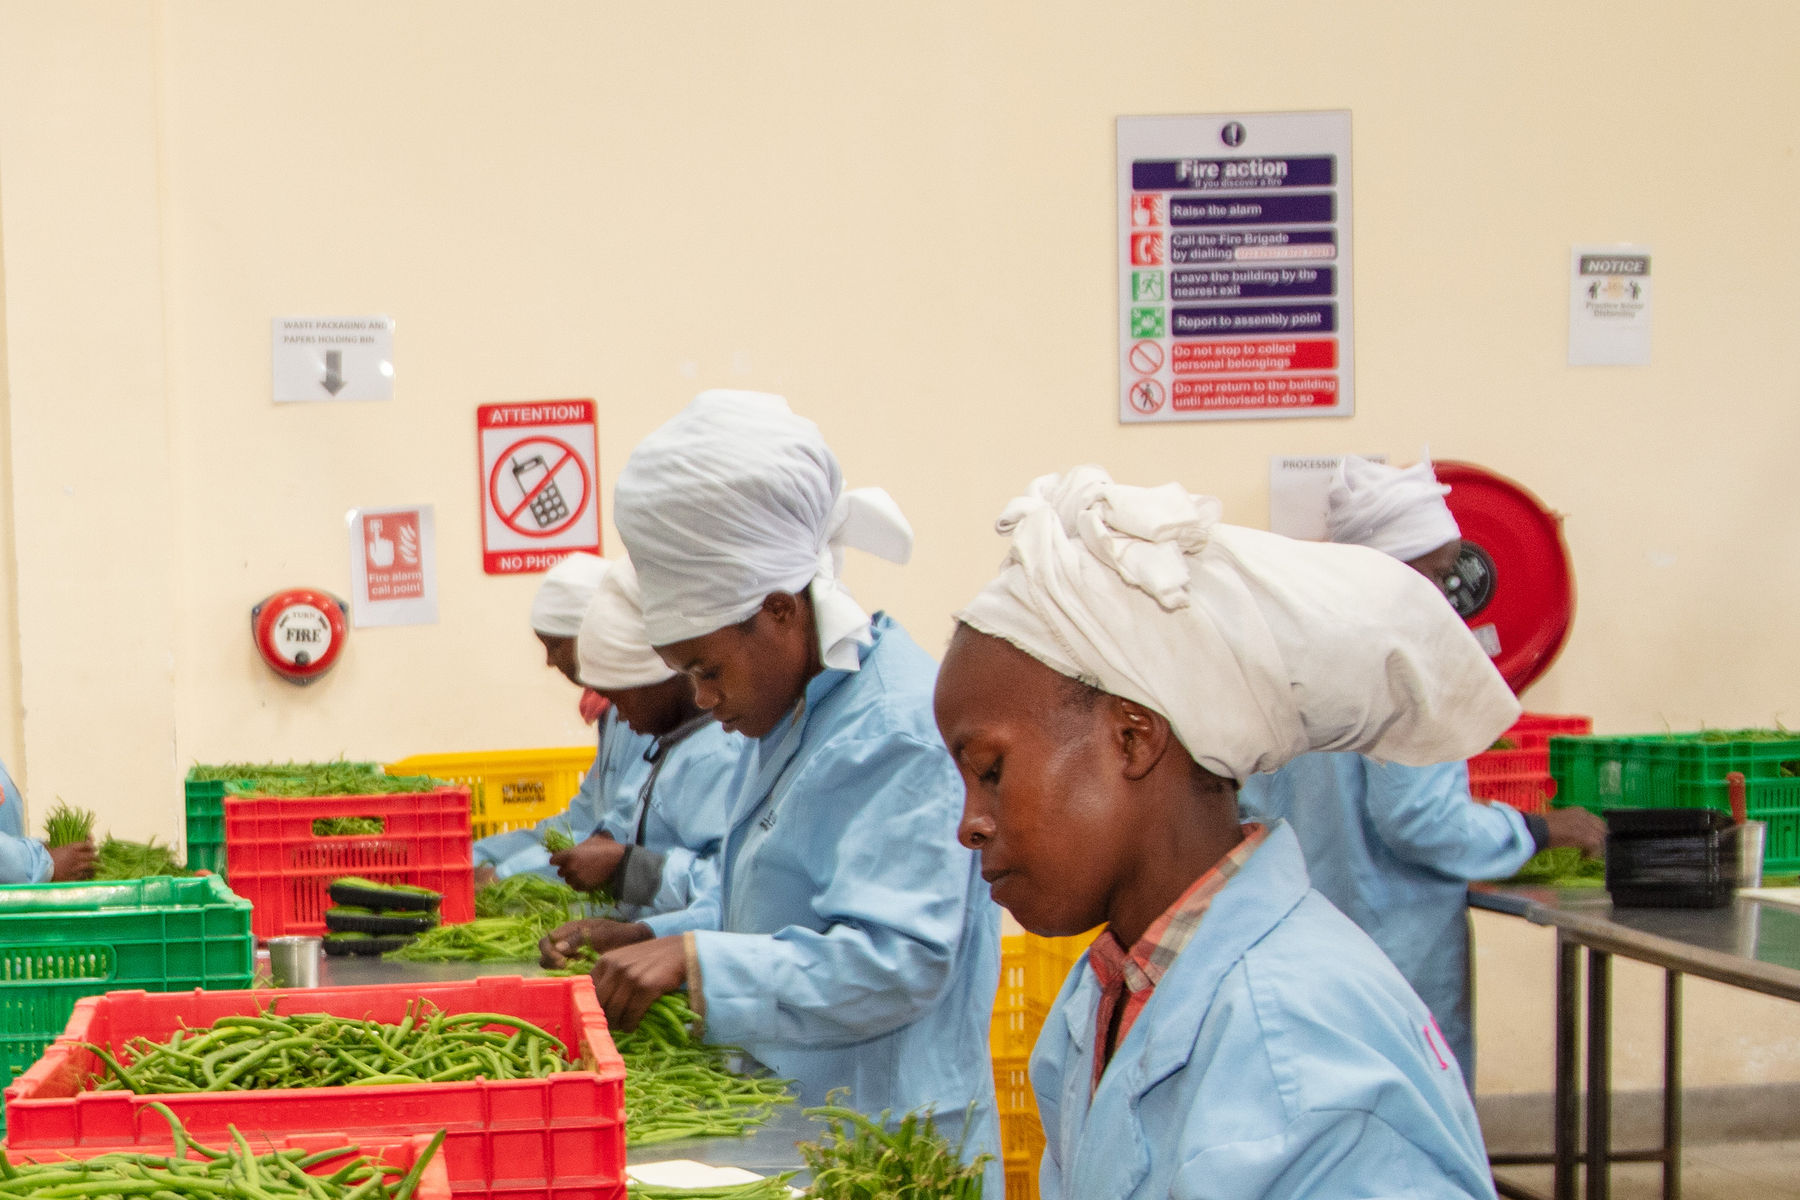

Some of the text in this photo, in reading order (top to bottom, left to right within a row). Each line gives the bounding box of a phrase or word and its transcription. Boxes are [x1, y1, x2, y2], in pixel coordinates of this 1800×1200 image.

[1180, 158, 1288, 178] Fire action
[1173, 203, 1262, 217] Raise the alarm
[1173, 233, 1289, 247] Call the Fire Brigade
[1173, 248, 1187, 262] by
[1190, 247, 1233, 261] dialling
[1588, 261, 1644, 272] NOTICE
[1174, 268, 1317, 284] Leave the building by the
[1174, 284, 1241, 296] nearest exit
[283, 321, 312, 329] WASTE
[316, 321, 367, 329] PACKAGING
[1178, 312, 1322, 329] Report to assembly point
[318, 335, 357, 343] HOLDING
[1174, 342, 1296, 357] Do not stop to collect
[1174, 356, 1291, 371] personal belongings
[1175, 379, 1336, 393] Do not return to the building
[1175, 393, 1314, 407] until authorised to do so
[491, 404, 585, 424] ATTENTION!
[1282, 459, 1338, 469] PROCESSIN
[501, 554, 569, 570] NO PHON
[368, 571, 422, 583] Fire alarm
[372, 582, 421, 595] call point
[286, 628, 321, 642] FIRE
